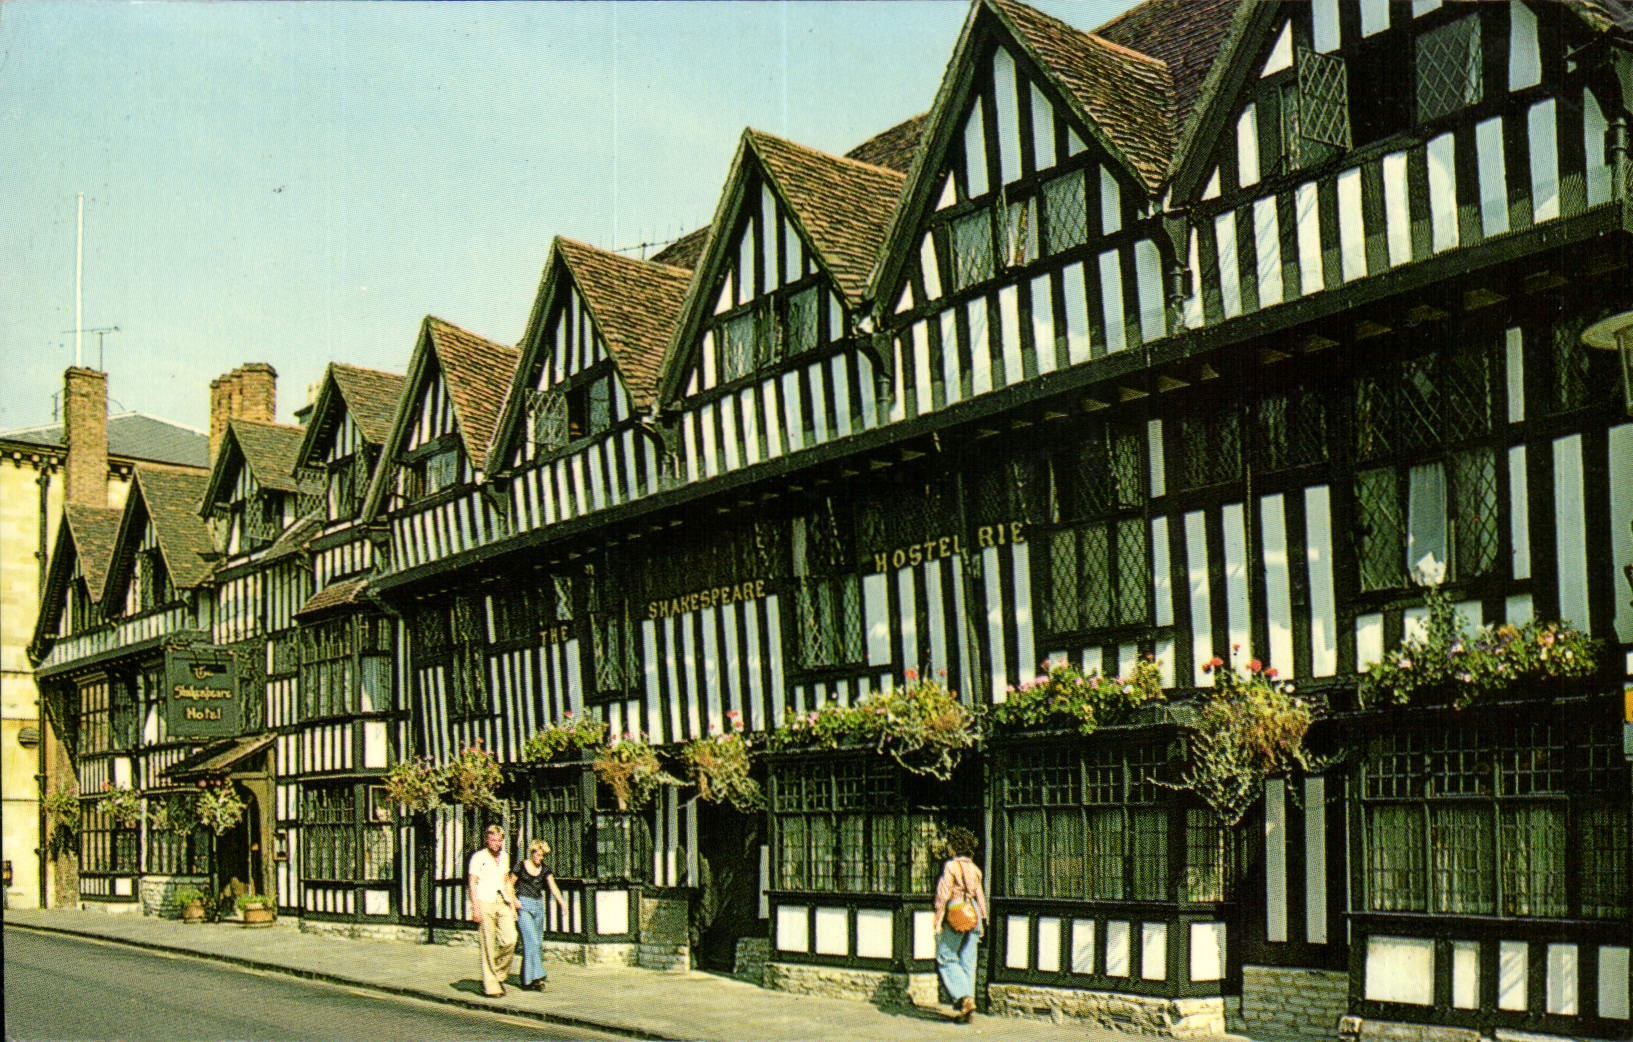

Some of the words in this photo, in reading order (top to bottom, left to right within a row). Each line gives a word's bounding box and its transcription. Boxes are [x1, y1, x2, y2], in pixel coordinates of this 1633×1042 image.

[539, 625, 569, 647] THE
[648, 580, 767, 620] SHAKESPEARE
[186, 707, 220, 720] Hotel
